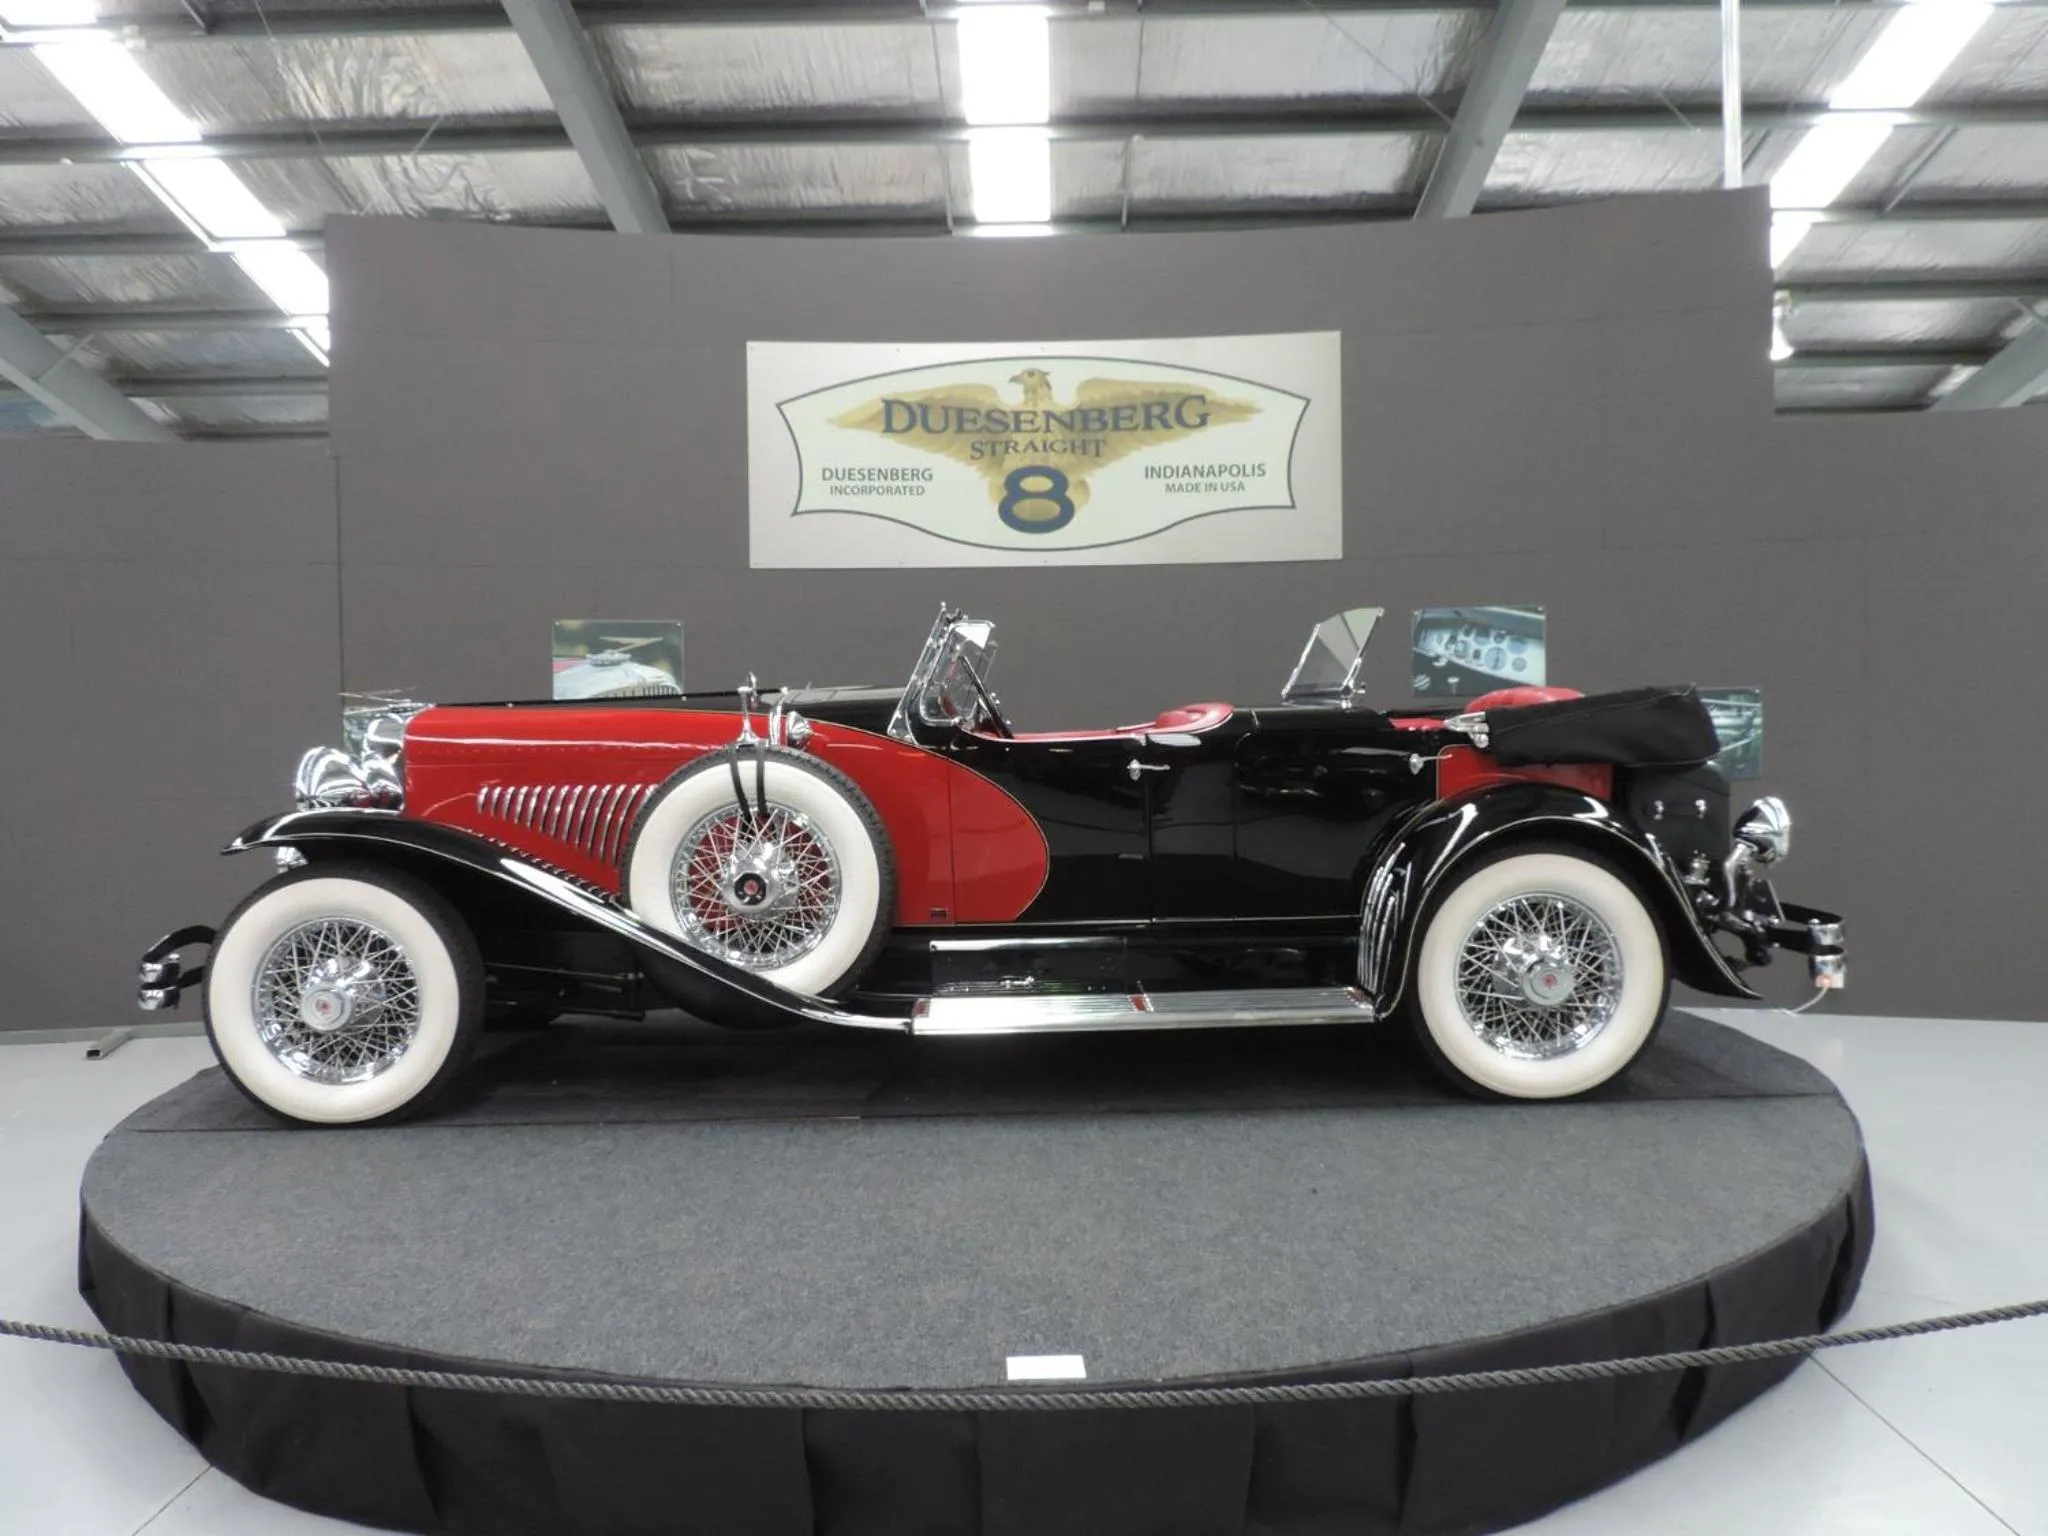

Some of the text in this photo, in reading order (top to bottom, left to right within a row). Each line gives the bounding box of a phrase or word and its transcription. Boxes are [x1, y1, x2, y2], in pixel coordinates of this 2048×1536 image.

[881, 394, 1211, 434] DUESENBERG
[970, 437, 1109, 460] STRAIGHT
[821, 467, 934, 482] DUESENBERG
[1144, 463, 1267, 479] INDIANAPOLIS
[829, 484, 926, 496] INCORPORATED
[1165, 481, 1246, 493] MADE IN USA
[998, 465, 1075, 534] 8
